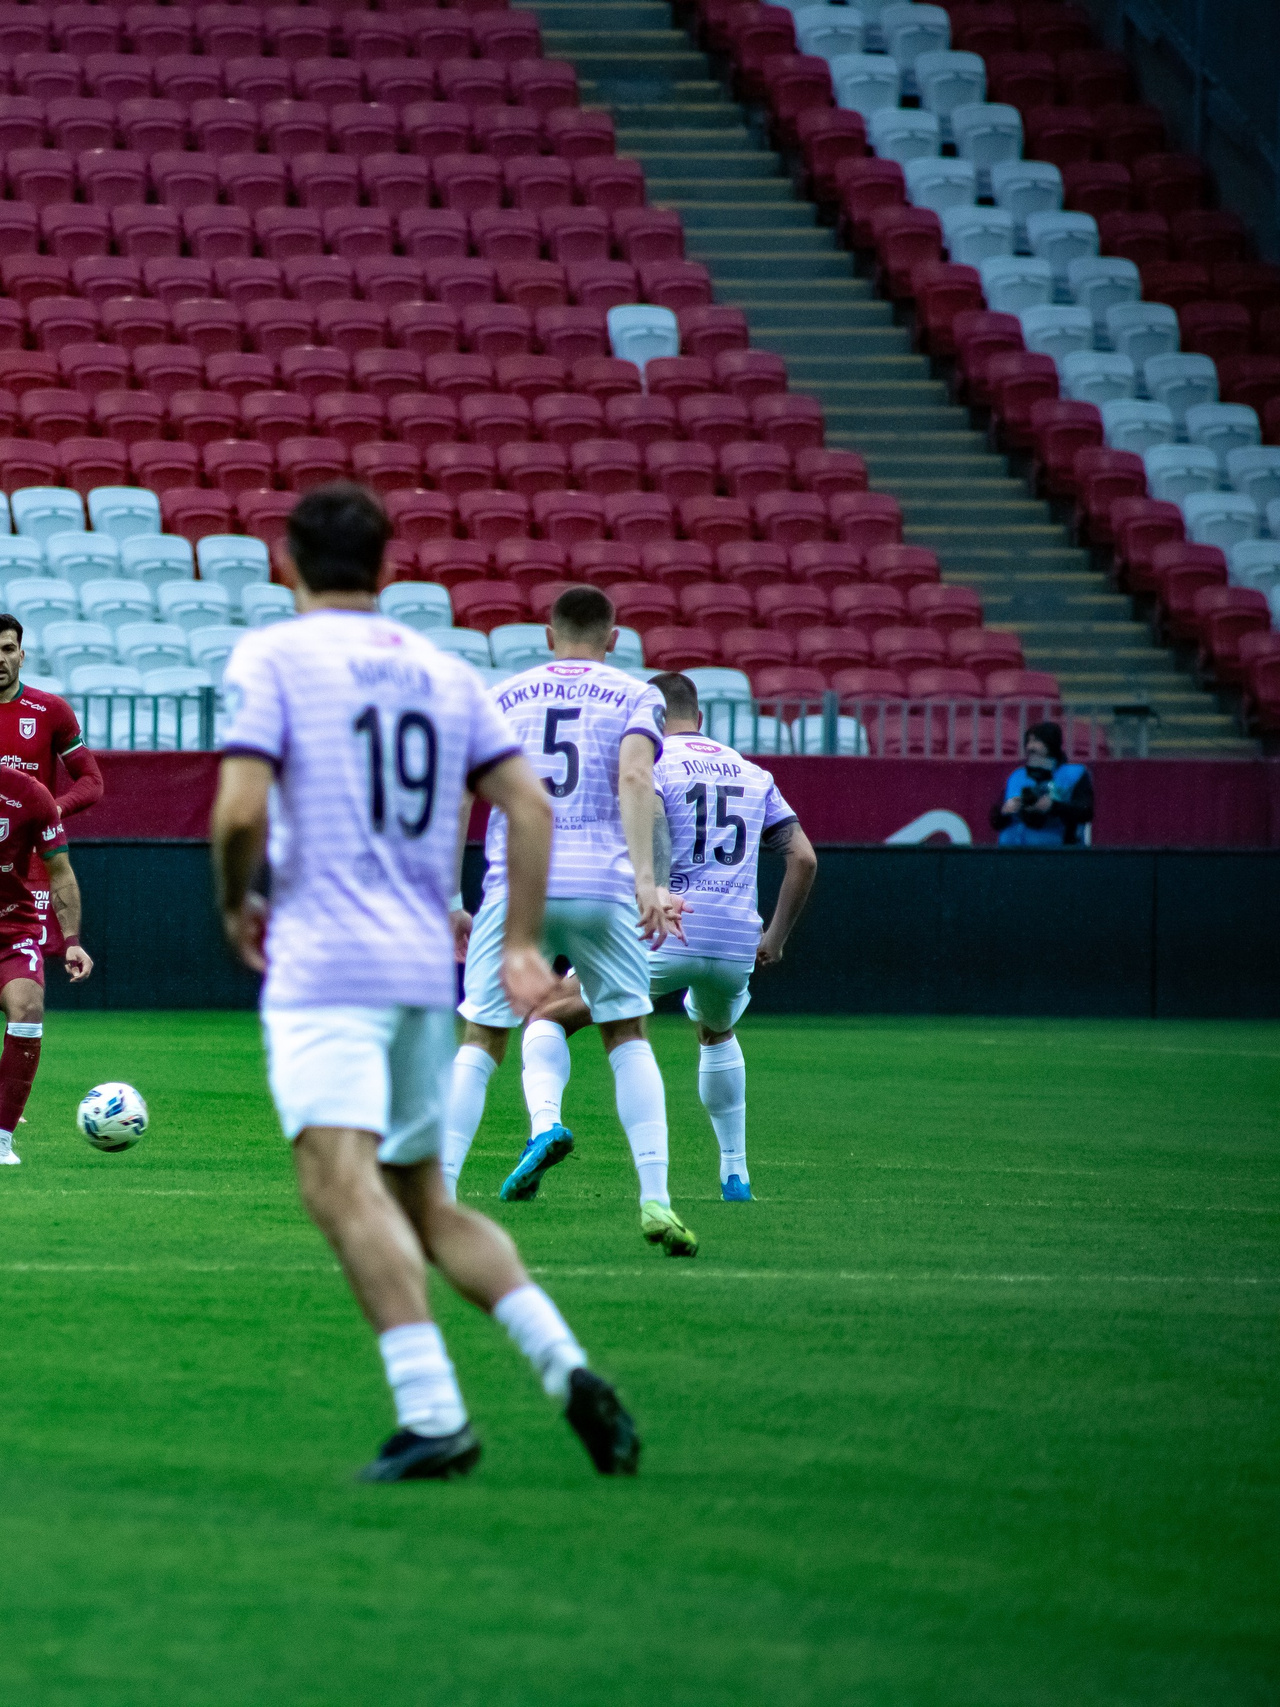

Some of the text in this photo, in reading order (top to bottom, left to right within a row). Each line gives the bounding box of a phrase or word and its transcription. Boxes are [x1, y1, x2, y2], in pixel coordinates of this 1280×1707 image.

[497, 682, 627, 714] ДЖУРАСОВИЧ
[540, 707, 582, 798] 5
[354, 703, 441, 840] 19
[682, 760, 742, 778] ЛОНЧАР
[685, 782, 747, 866] 15
[695, 885, 730, 894] САМАРА
[20, 948, 38, 972] 7
